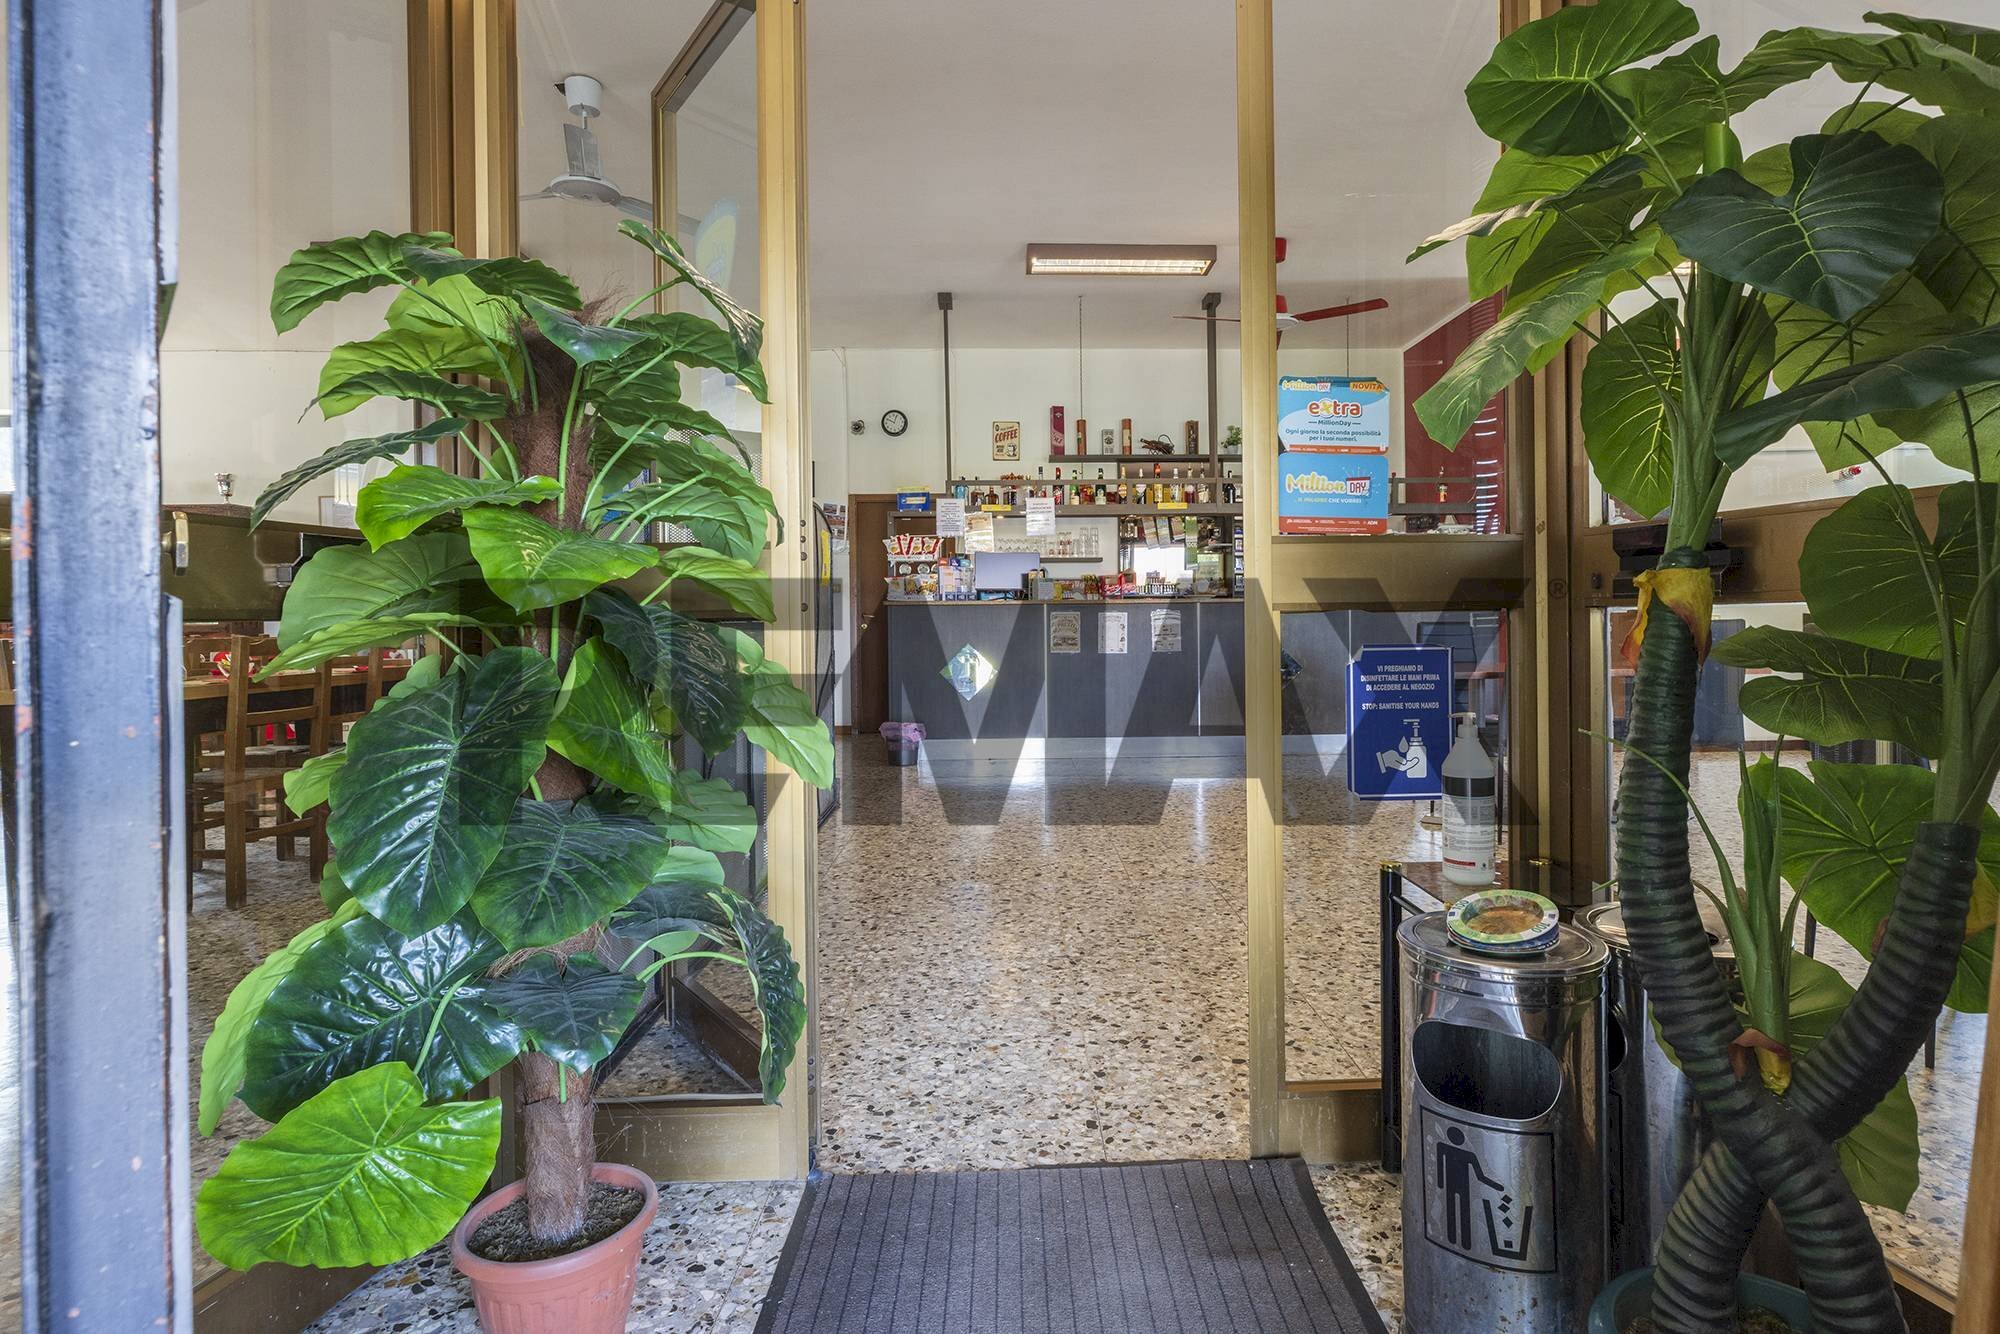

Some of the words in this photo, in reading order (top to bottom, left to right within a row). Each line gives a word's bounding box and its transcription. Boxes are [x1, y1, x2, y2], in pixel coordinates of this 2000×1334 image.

[1308, 399, 1361, 416] extra
[995, 428, 1018, 443] COFFEE
[1286, 472, 1346, 494] Million
[1349, 482, 1367, 493] DAY
[1361, 674, 1399, 682] DISINFETTARE
